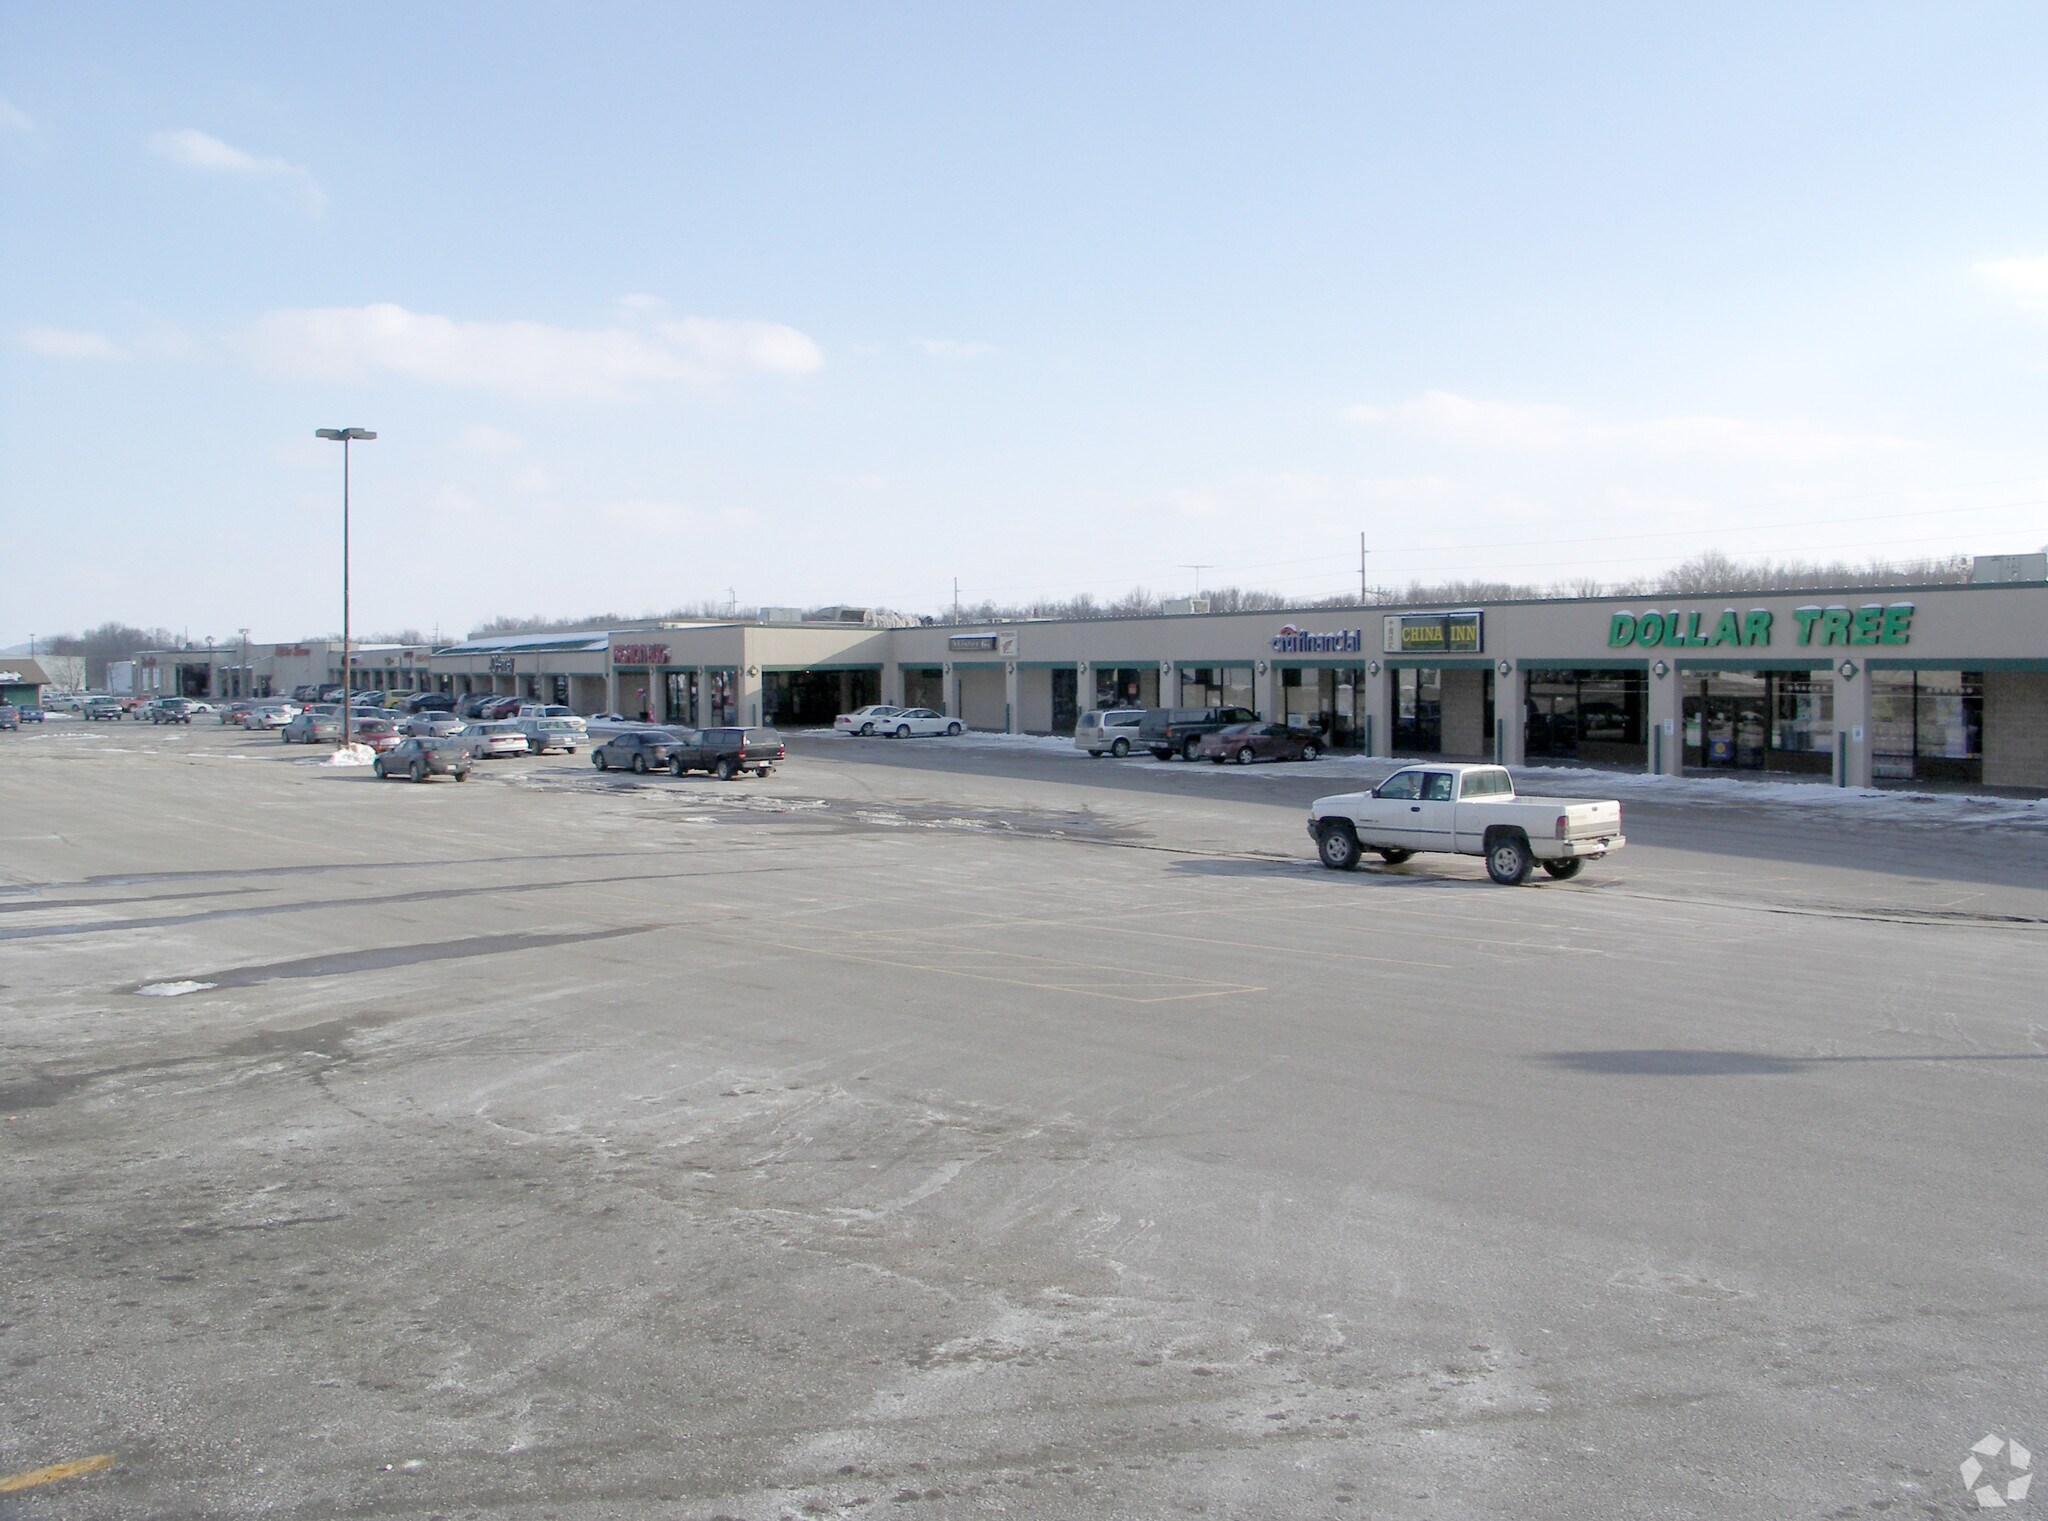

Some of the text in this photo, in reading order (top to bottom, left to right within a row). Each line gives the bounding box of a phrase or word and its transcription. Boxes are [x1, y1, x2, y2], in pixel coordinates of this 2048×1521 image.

[1402, 625, 1443, 642] CHINA
[1450, 625, 1476, 641] INN
[1608, 602, 1915, 648] DOLLAR TREE
